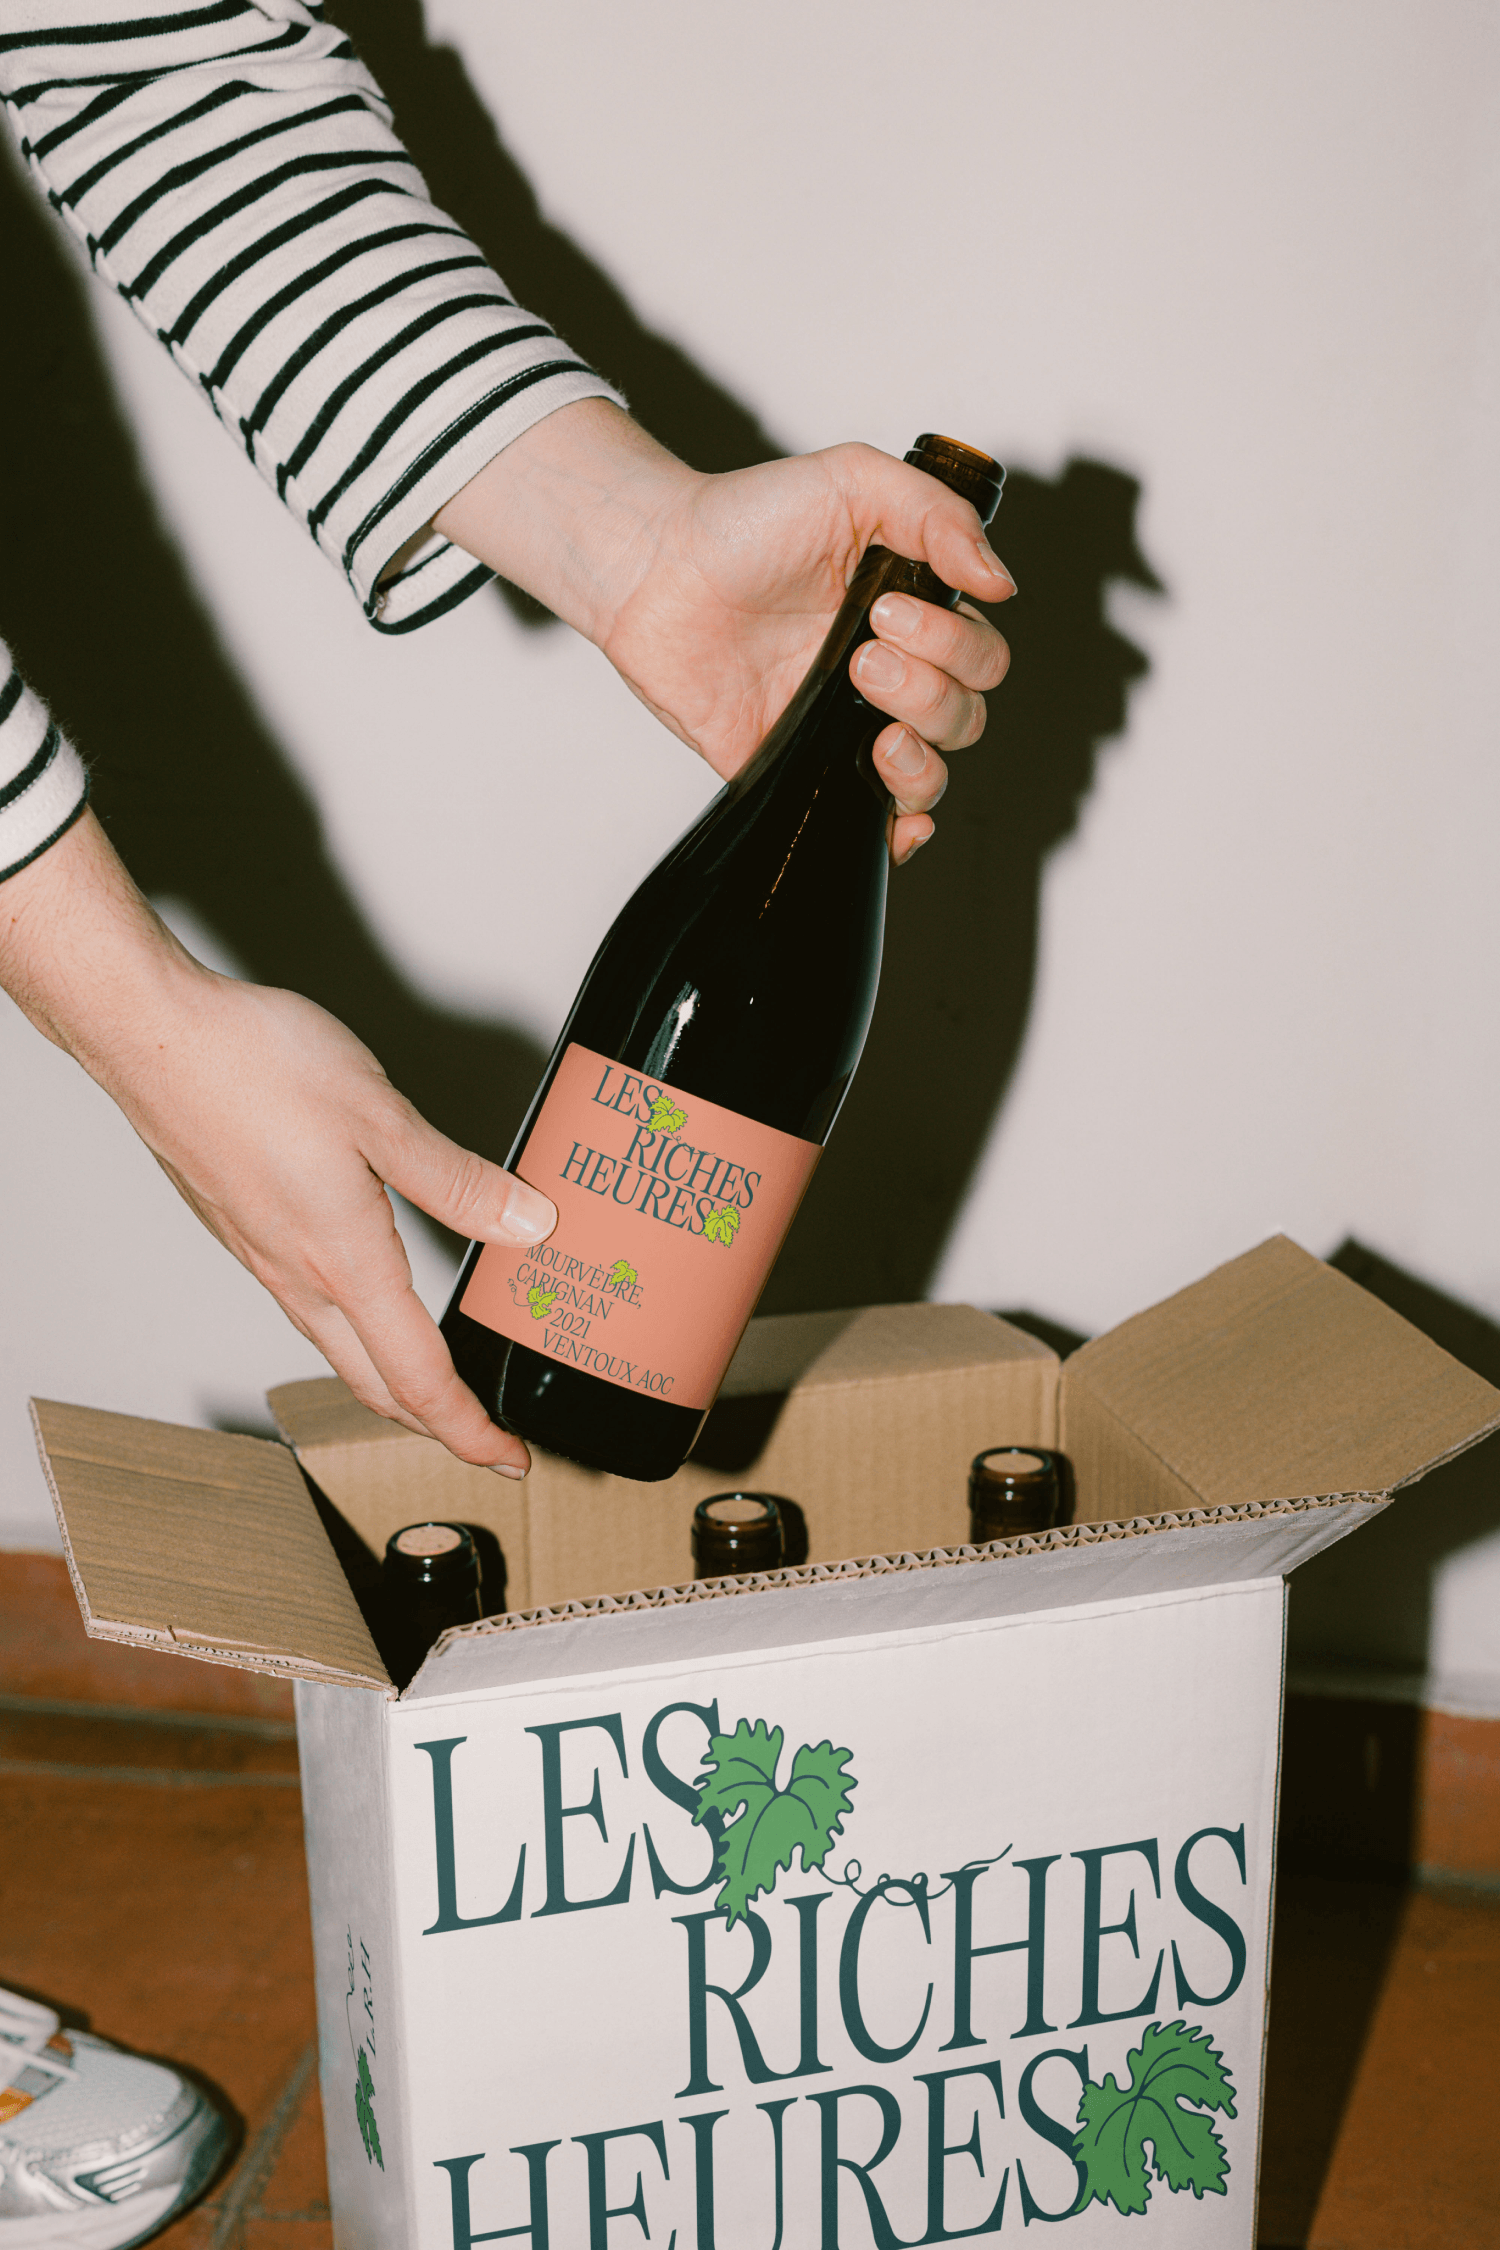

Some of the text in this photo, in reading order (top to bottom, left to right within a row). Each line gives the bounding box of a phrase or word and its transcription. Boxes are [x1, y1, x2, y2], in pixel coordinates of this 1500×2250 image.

[591, 1064, 664, 1124] LES
[559, 1141, 716, 1237] HEURES
[622, 1124, 762, 1209] RICHES
[516, 1263, 615, 1321] CARIGNAN
[549, 1307, 593, 1340] 2021
[543, 1328, 675, 1396] VENTOUX AOC
[413, 1697, 726, 1936] LES
[671, 1822, 1247, 2099] RICHES
